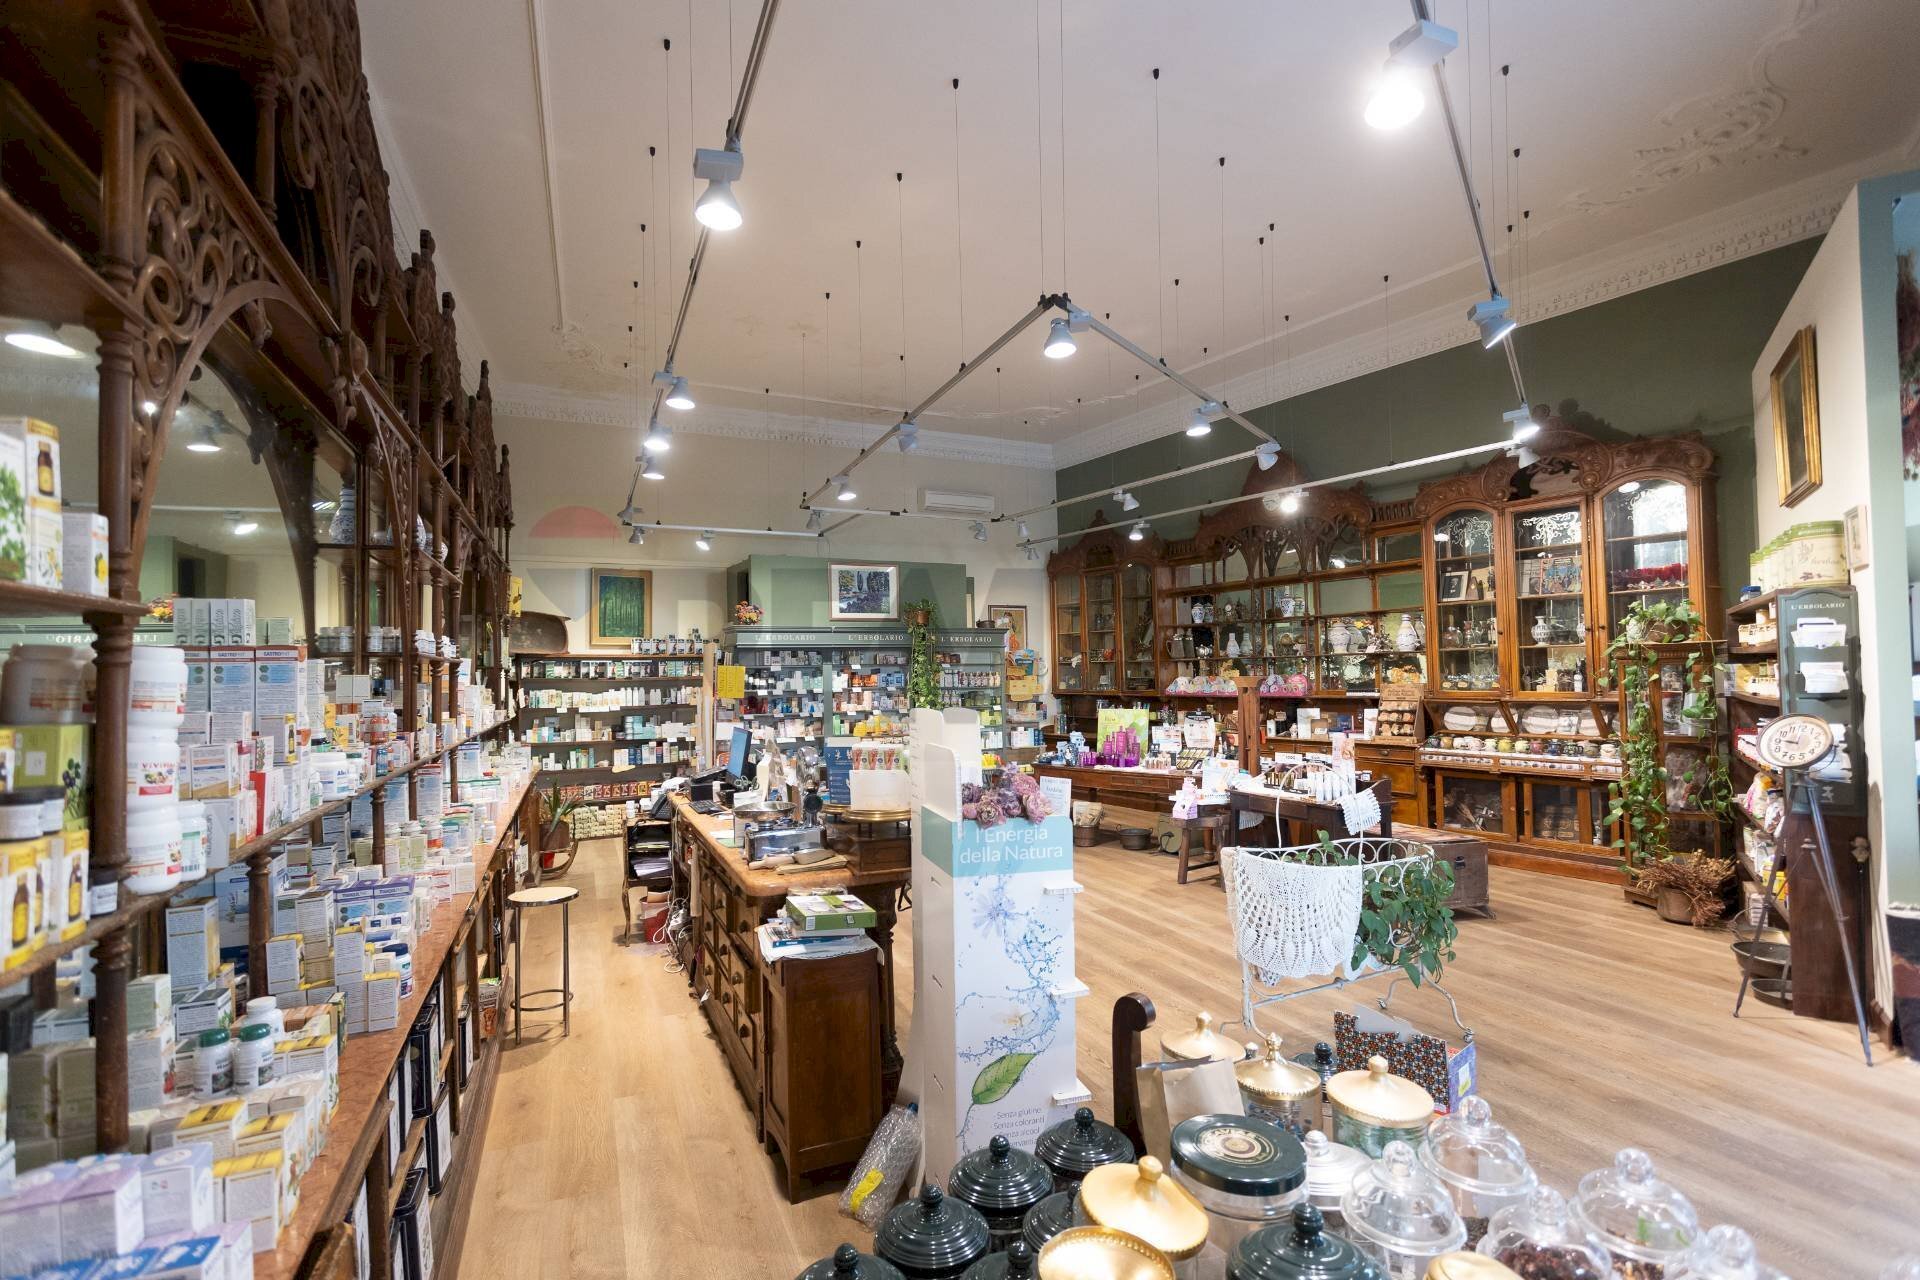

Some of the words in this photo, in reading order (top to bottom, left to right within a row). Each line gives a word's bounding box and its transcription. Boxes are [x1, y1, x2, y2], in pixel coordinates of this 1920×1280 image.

[1791, 602, 1846, 610] L'ERBOLARIO
[1780, 730, 1788, 738] 10
[1774, 745, 1781, 753] 8
[1789, 753, 1796, 761] 6
[976, 825, 1048, 844] l'Energia
[960, 846, 1000, 864] della
[1005, 845, 1063, 861] Natura
[996, 1110, 1017, 1119] Senza
[993, 1121, 1014, 1130] Senza
